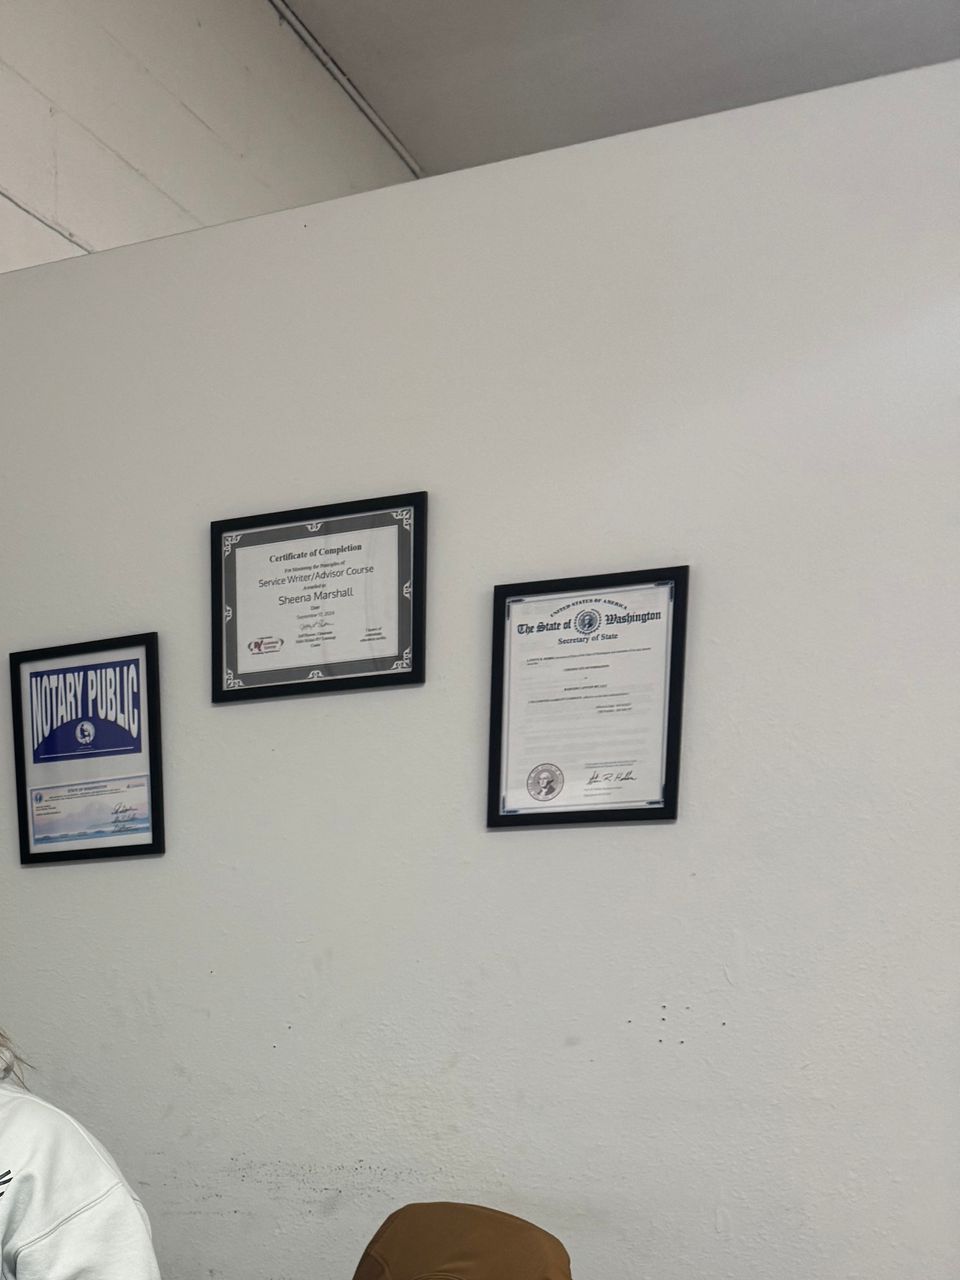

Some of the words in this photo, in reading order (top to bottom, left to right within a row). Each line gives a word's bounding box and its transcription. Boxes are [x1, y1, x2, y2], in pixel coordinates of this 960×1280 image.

[269, 551, 308, 563] Certificate
[309, 549, 317, 557] of
[318, 544, 362, 555] Completion
[258, 578, 285, 588] Service
[287, 569, 344, 584] Writer/Advisor
[346, 566, 374, 575] Course
[278, 593, 311, 605] Sheena
[314, 587, 353, 600] Marshall
[604, 600, 628, 610] AMERICA
[517, 624, 534, 635] The
[536, 622, 561, 632] State
[563, 619, 572, 629] of
[605, 611, 662, 624] Washington
[558, 635, 590, 645] Secretary
[31, 671, 84, 750] NOTARY
[88, 664, 139, 739] PUBLIC
